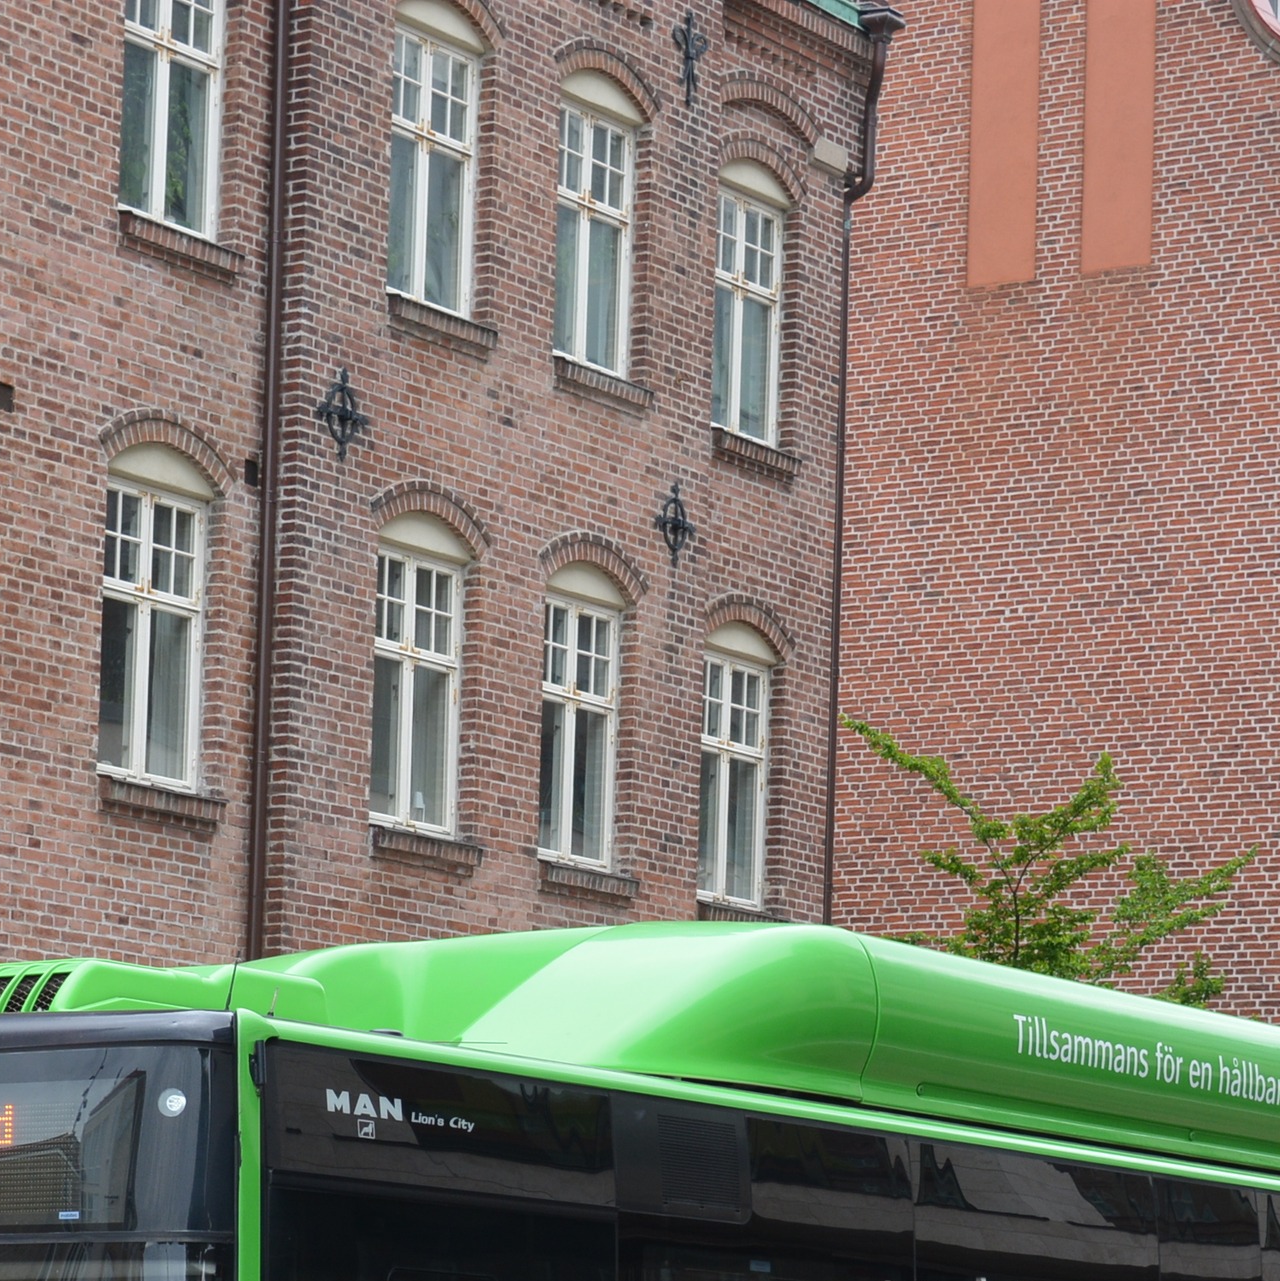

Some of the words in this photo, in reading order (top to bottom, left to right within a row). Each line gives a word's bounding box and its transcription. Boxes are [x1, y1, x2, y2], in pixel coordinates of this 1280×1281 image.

[1013, 1014, 1149, 1078] Tillsammans
[1155, 1042, 1182, 1084] för
[1188, 1060, 1213, 1091] en
[325, 1088, 403, 1121] MAN
[411, 1111, 444, 1127] Lion's
[449, 1116, 475, 1132] City
